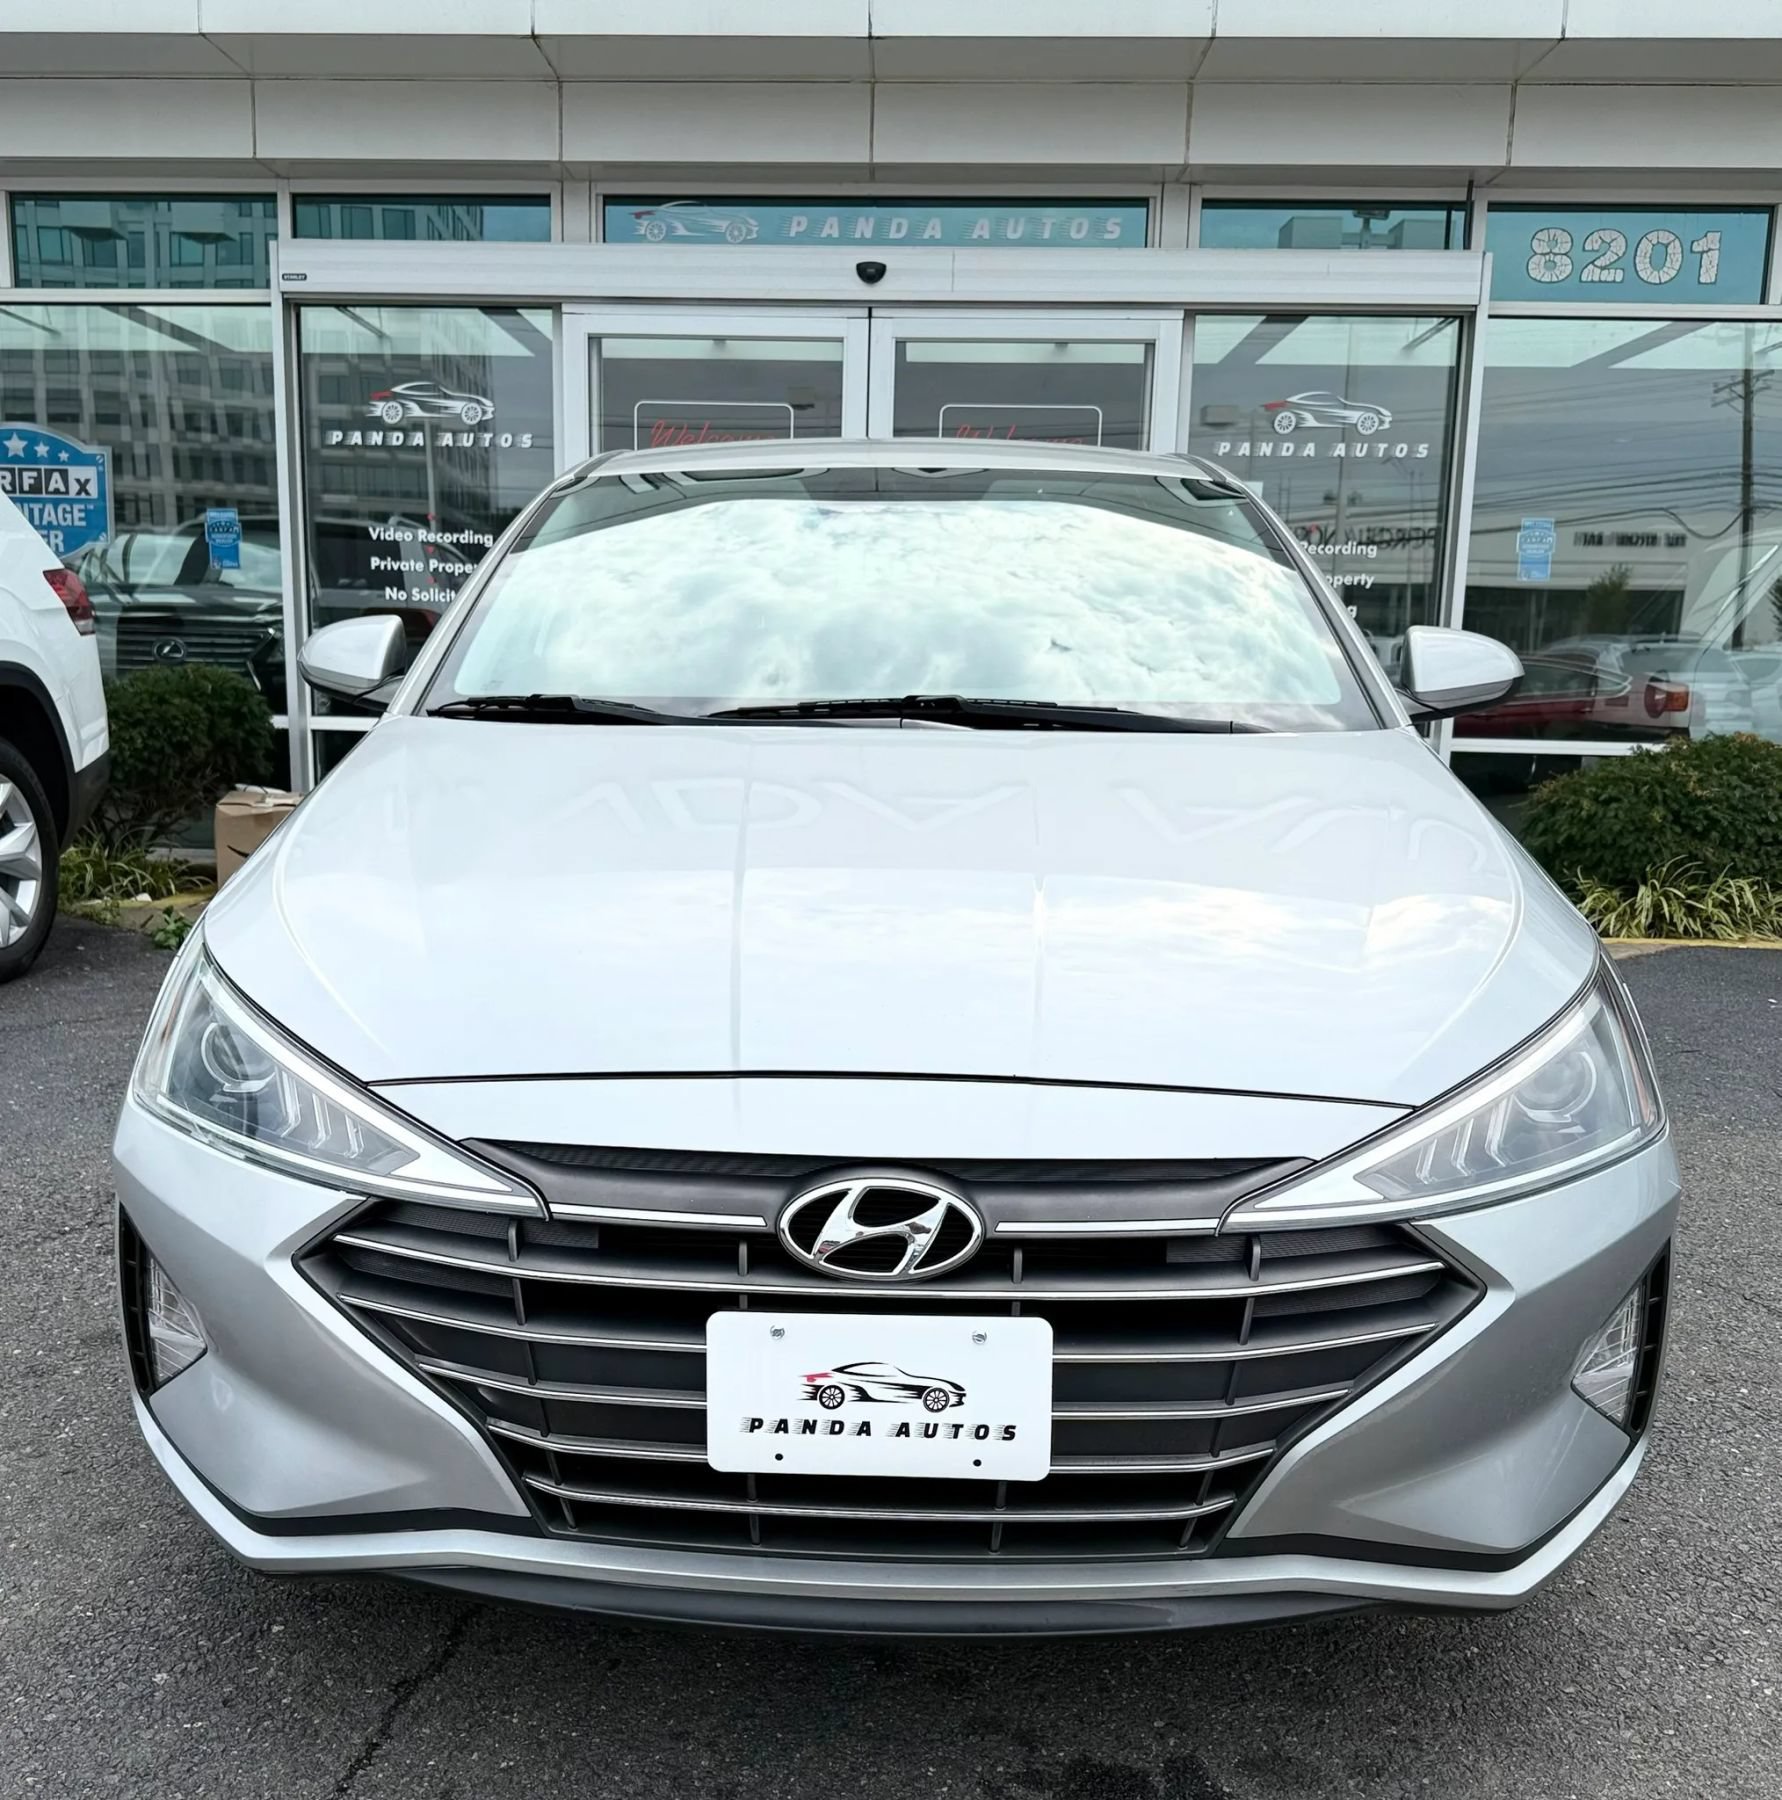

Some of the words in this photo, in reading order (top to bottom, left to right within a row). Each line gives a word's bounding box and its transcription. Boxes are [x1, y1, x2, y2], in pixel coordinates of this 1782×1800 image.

[784, 216, 942, 240] PANDA
[966, 217, 1122, 240] AUTOS
[1527, 227, 1722, 285] 8201
[328, 430, 424, 446] PANDA
[439, 432, 533, 448] AUTOS
[1215, 441, 1315, 457] PANDA
[1330, 443, 1429, 458] AUTOS
[368, 527, 413, 541] Video
[418, 529, 493, 546] Recording
[370, 557, 424, 572] Private
[385, 587, 407, 600] No
[742, 1417, 872, 1437] PANDA
[889, 1422, 1016, 1441] AUTOS
